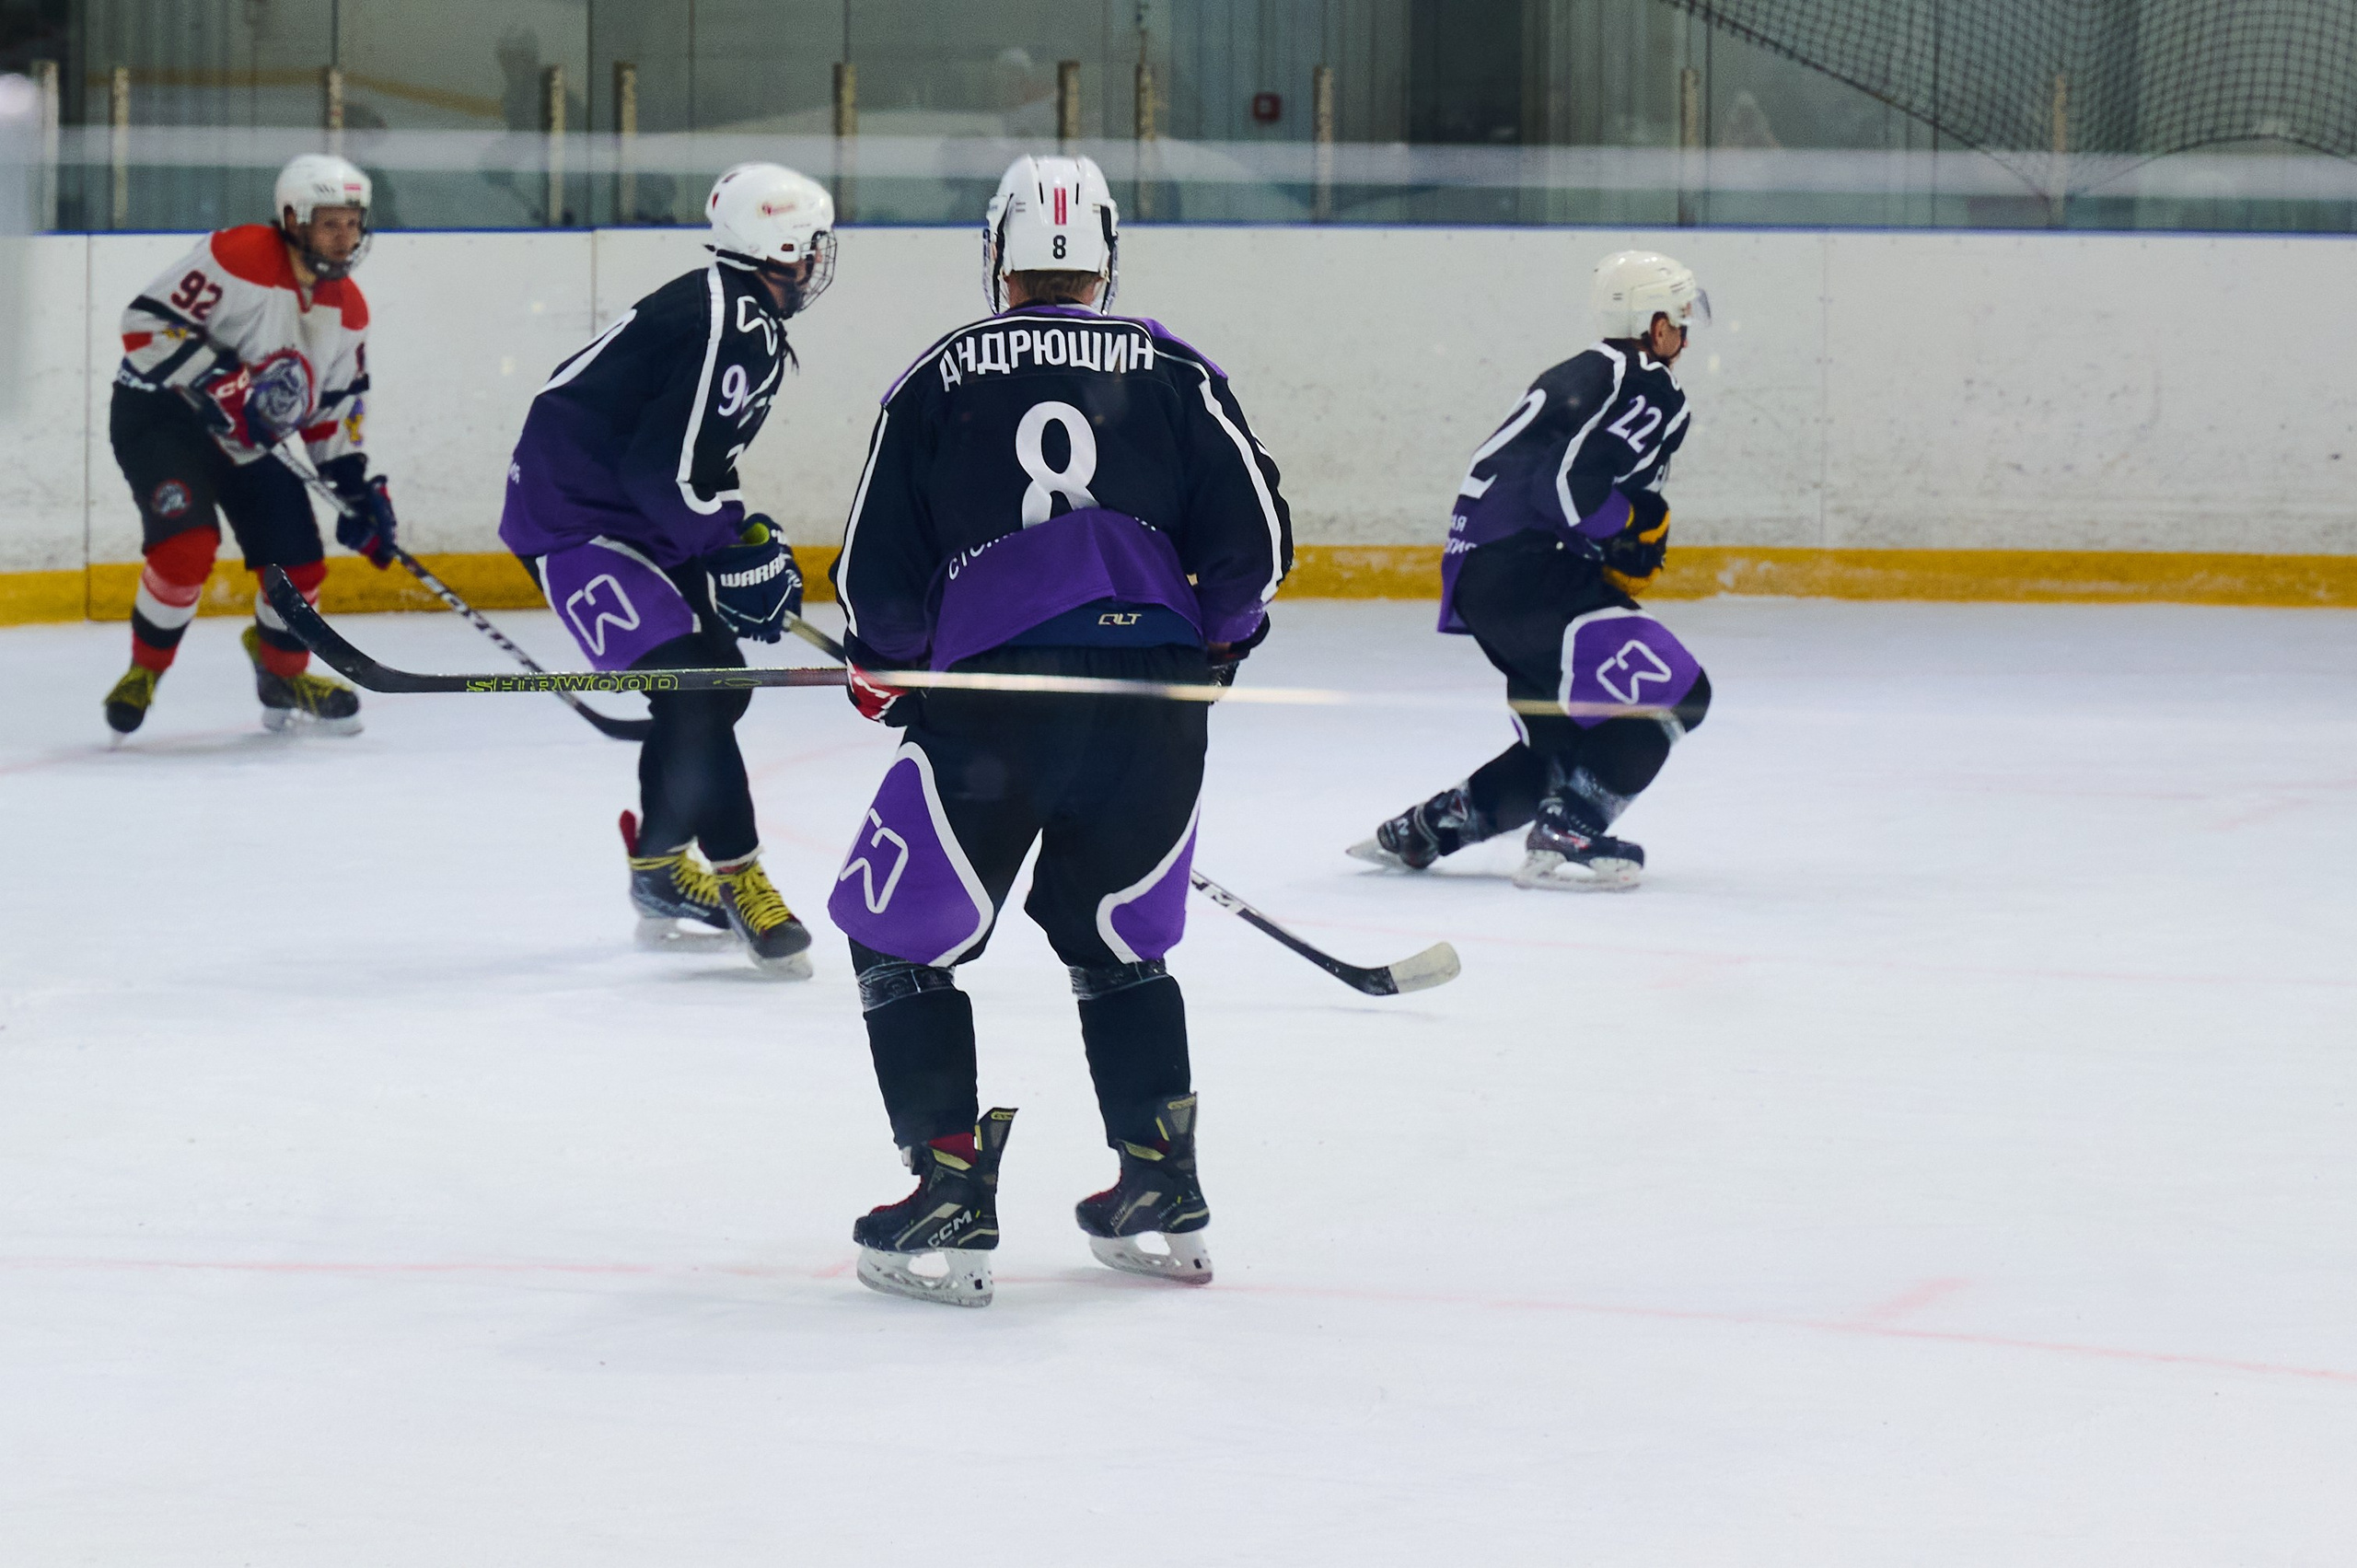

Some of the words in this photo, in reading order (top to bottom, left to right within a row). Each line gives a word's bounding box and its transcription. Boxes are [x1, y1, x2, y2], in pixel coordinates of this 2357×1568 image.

[1052, 235, 1067, 260] 8
[171, 270, 223, 320] 92
[939, 329, 1154, 392] АНДРЮШИН
[718, 364, 749, 417] 9
[1607, 395, 1663, 454] 22
[1016, 401, 1101, 530] 8
[927, 1210, 973, 1248] CCM
